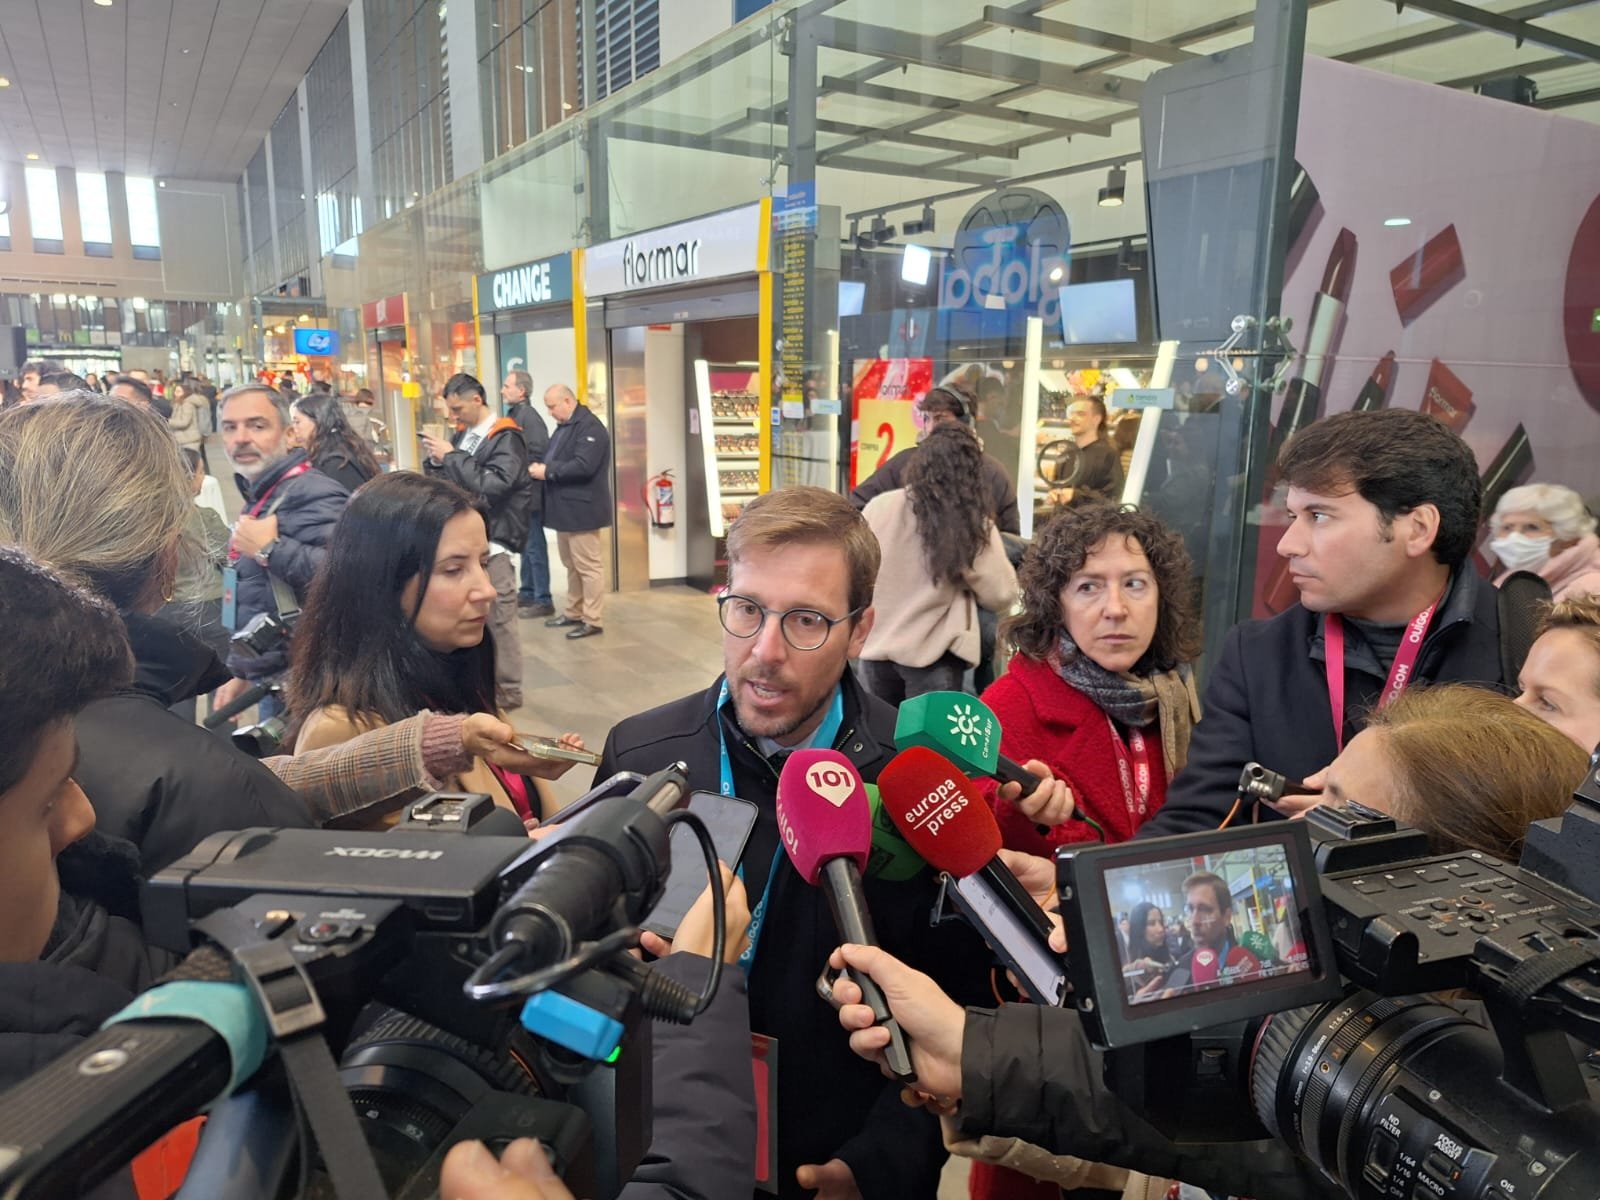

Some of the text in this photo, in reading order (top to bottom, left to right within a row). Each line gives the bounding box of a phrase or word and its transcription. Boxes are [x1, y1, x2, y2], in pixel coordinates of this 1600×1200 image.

[622, 238, 700, 287] flormar
[493, 262, 552, 308] CHANGE
[810, 770, 851, 788] 101
[905, 778, 956, 824] europa
[926, 795, 969, 836] press
[1380, 1118, 1401, 1138] FILTER
[1388, 1114, 1400, 1126] ND
[1434, 1141, 1462, 1160] ASSIST
[1438, 1134, 1464, 1154] FOCUS
[1416, 1171, 1445, 1196] MACRO
[1500, 1179, 1516, 1193] OIS
